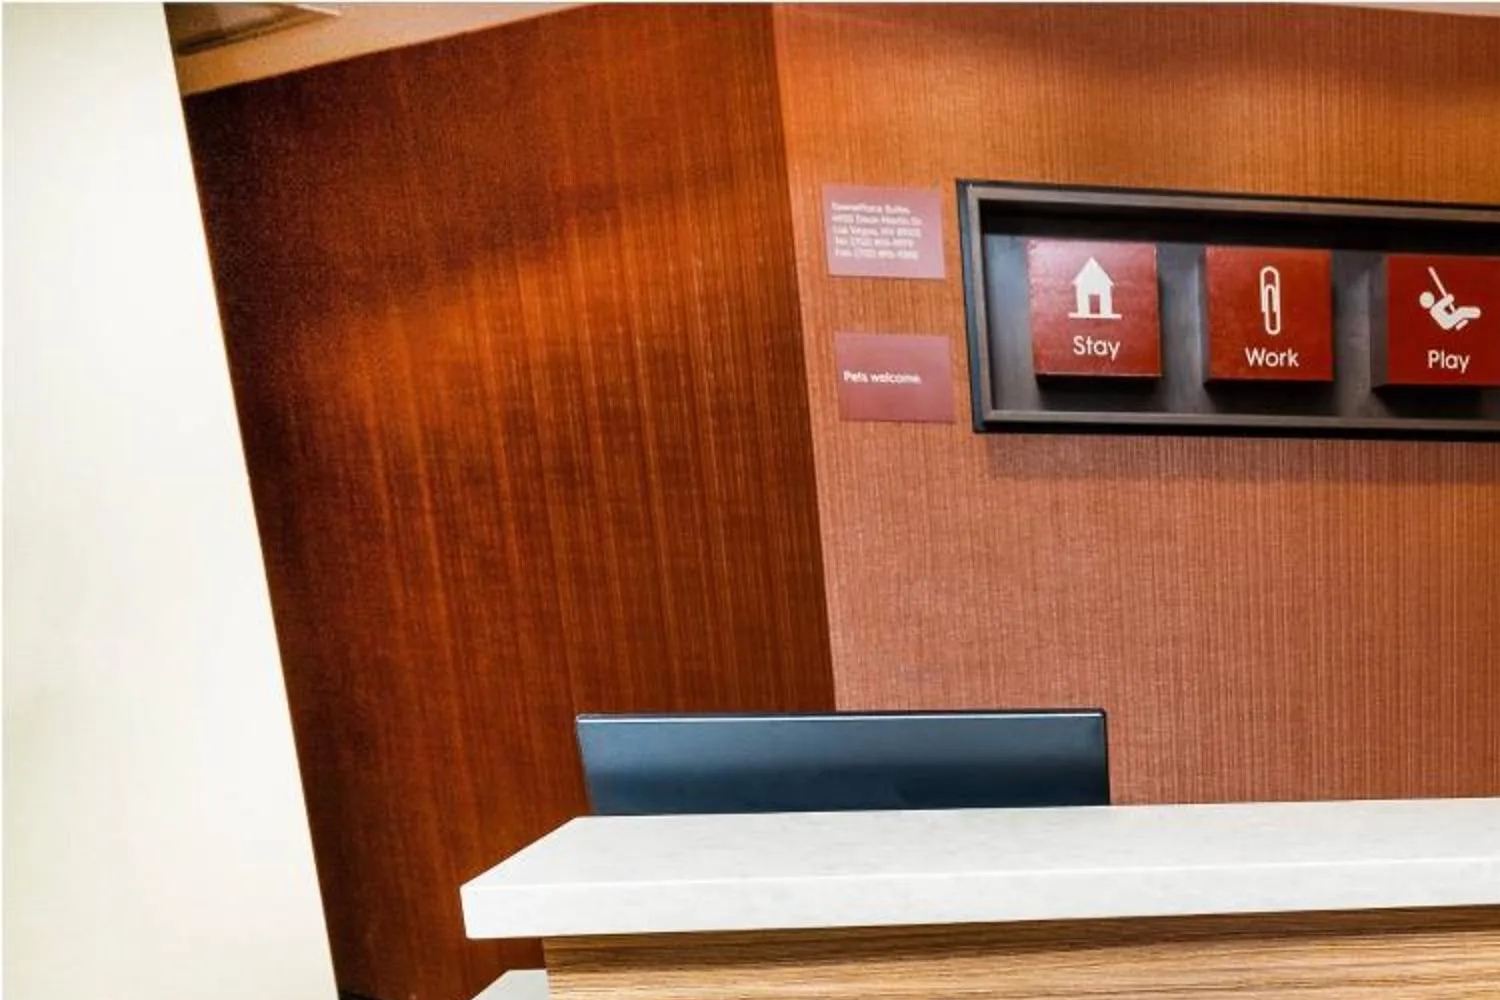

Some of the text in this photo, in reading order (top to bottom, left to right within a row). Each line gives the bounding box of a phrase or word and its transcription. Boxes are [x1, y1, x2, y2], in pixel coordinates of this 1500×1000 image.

[1072, 335, 1121, 361] Stay
[1244, 347, 1300, 368] Work
[1427, 349, 1471, 373] Play
[843, 370, 868, 383] Pets
